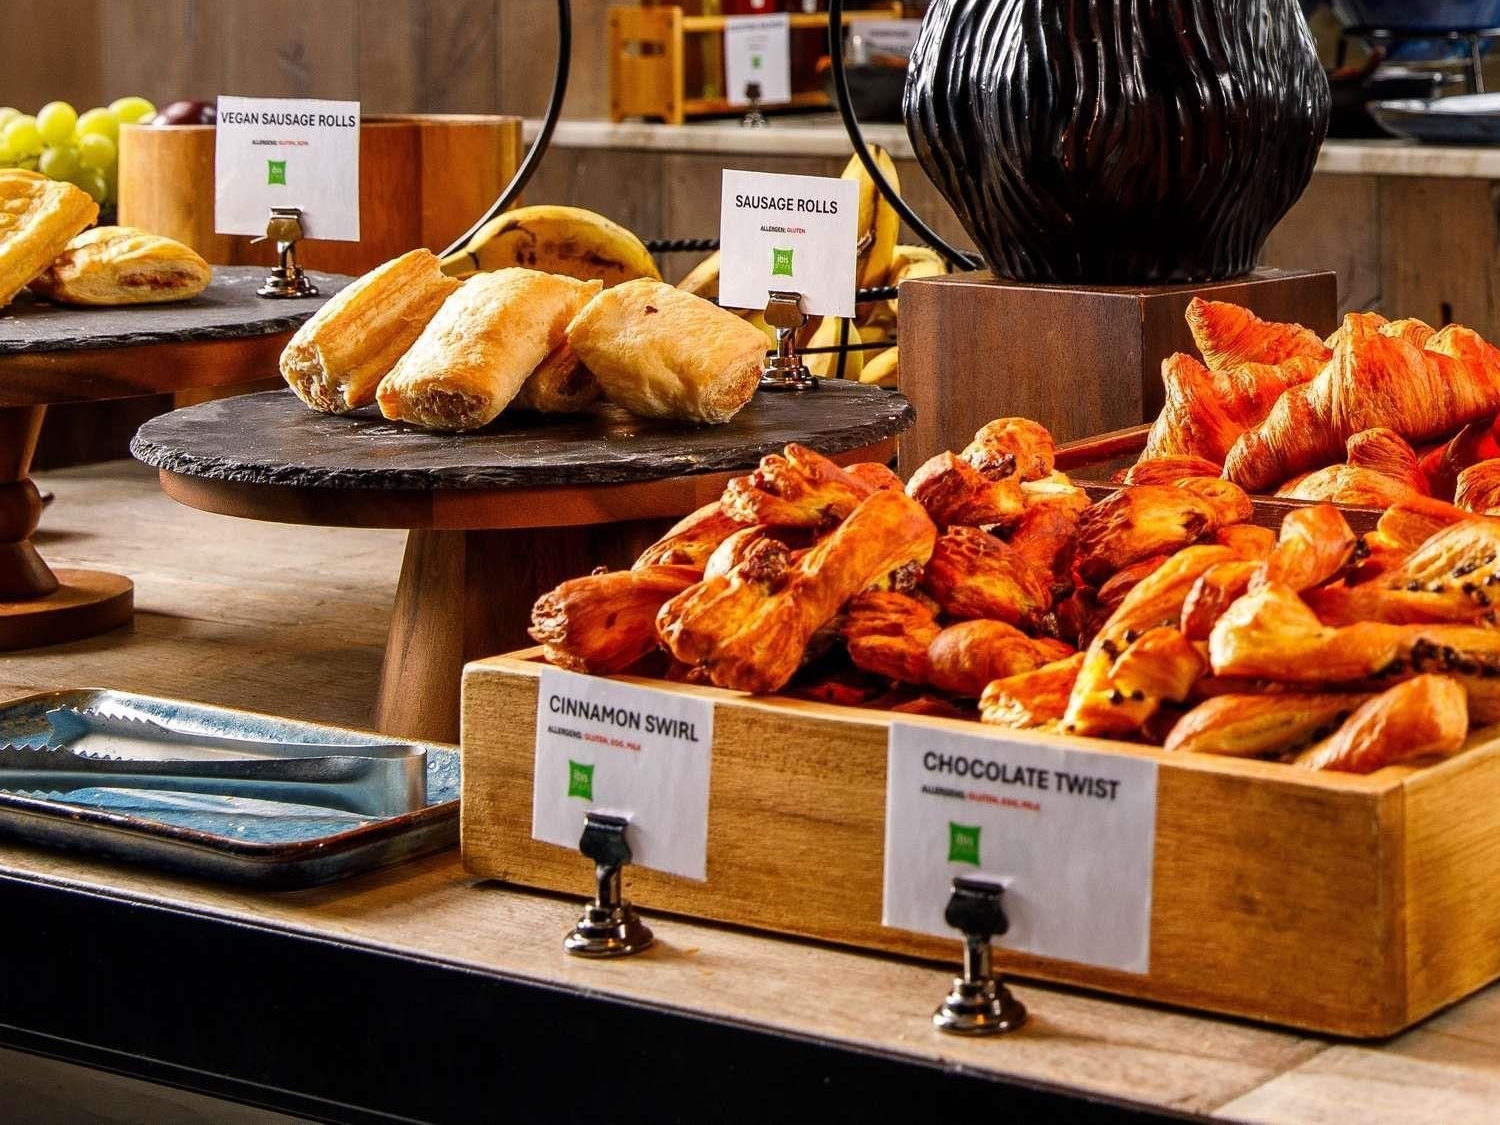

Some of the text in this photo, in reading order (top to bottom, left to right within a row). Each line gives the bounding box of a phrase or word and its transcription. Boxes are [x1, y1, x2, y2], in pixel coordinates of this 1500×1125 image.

[221, 112, 356, 128] VEGAN SAUSAGE ROLLS
[735, 194, 838, 214] SAUSAGE ROLLS
[787, 226, 806, 234] GLUTEN
[549, 694, 698, 742] CINNAMON SWIRL
[923, 751, 1121, 800] CHOCOLATE TWIST
